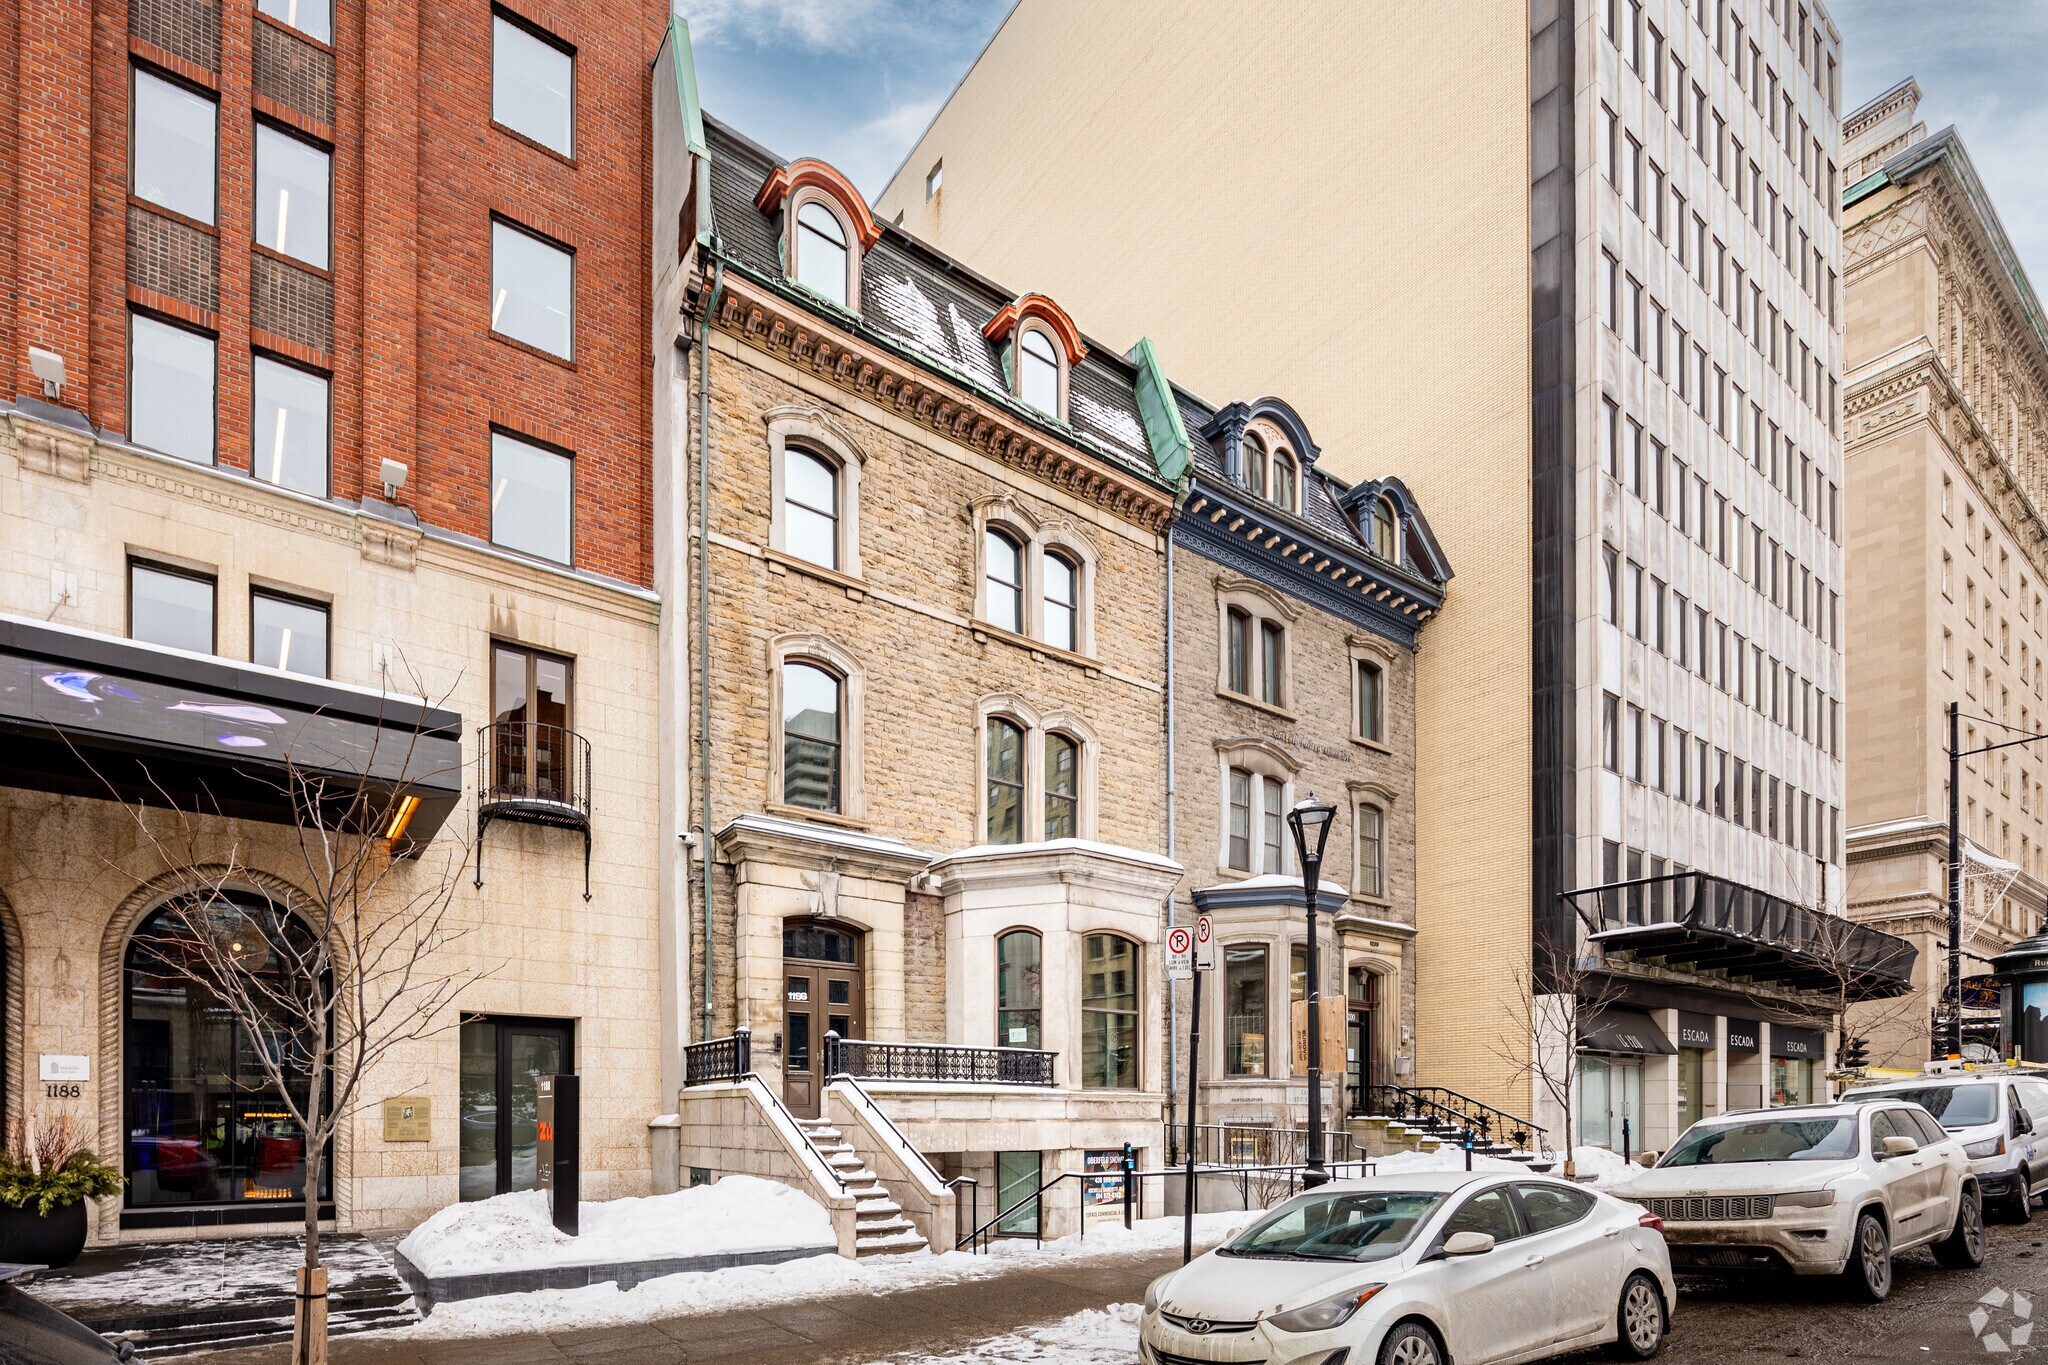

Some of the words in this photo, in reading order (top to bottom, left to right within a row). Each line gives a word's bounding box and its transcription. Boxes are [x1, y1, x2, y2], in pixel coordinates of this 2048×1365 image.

[1682, 1028, 1710, 1043] ESCADA
[1730, 1034, 1755, 1048] ESCADA
[1786, 1041, 1808, 1053] ESCADA
[47, 1085, 80, 1098] 1188
[541, 1081, 551, 1091] 1188
[1087, 1156, 1109, 1164] OBERFELD
